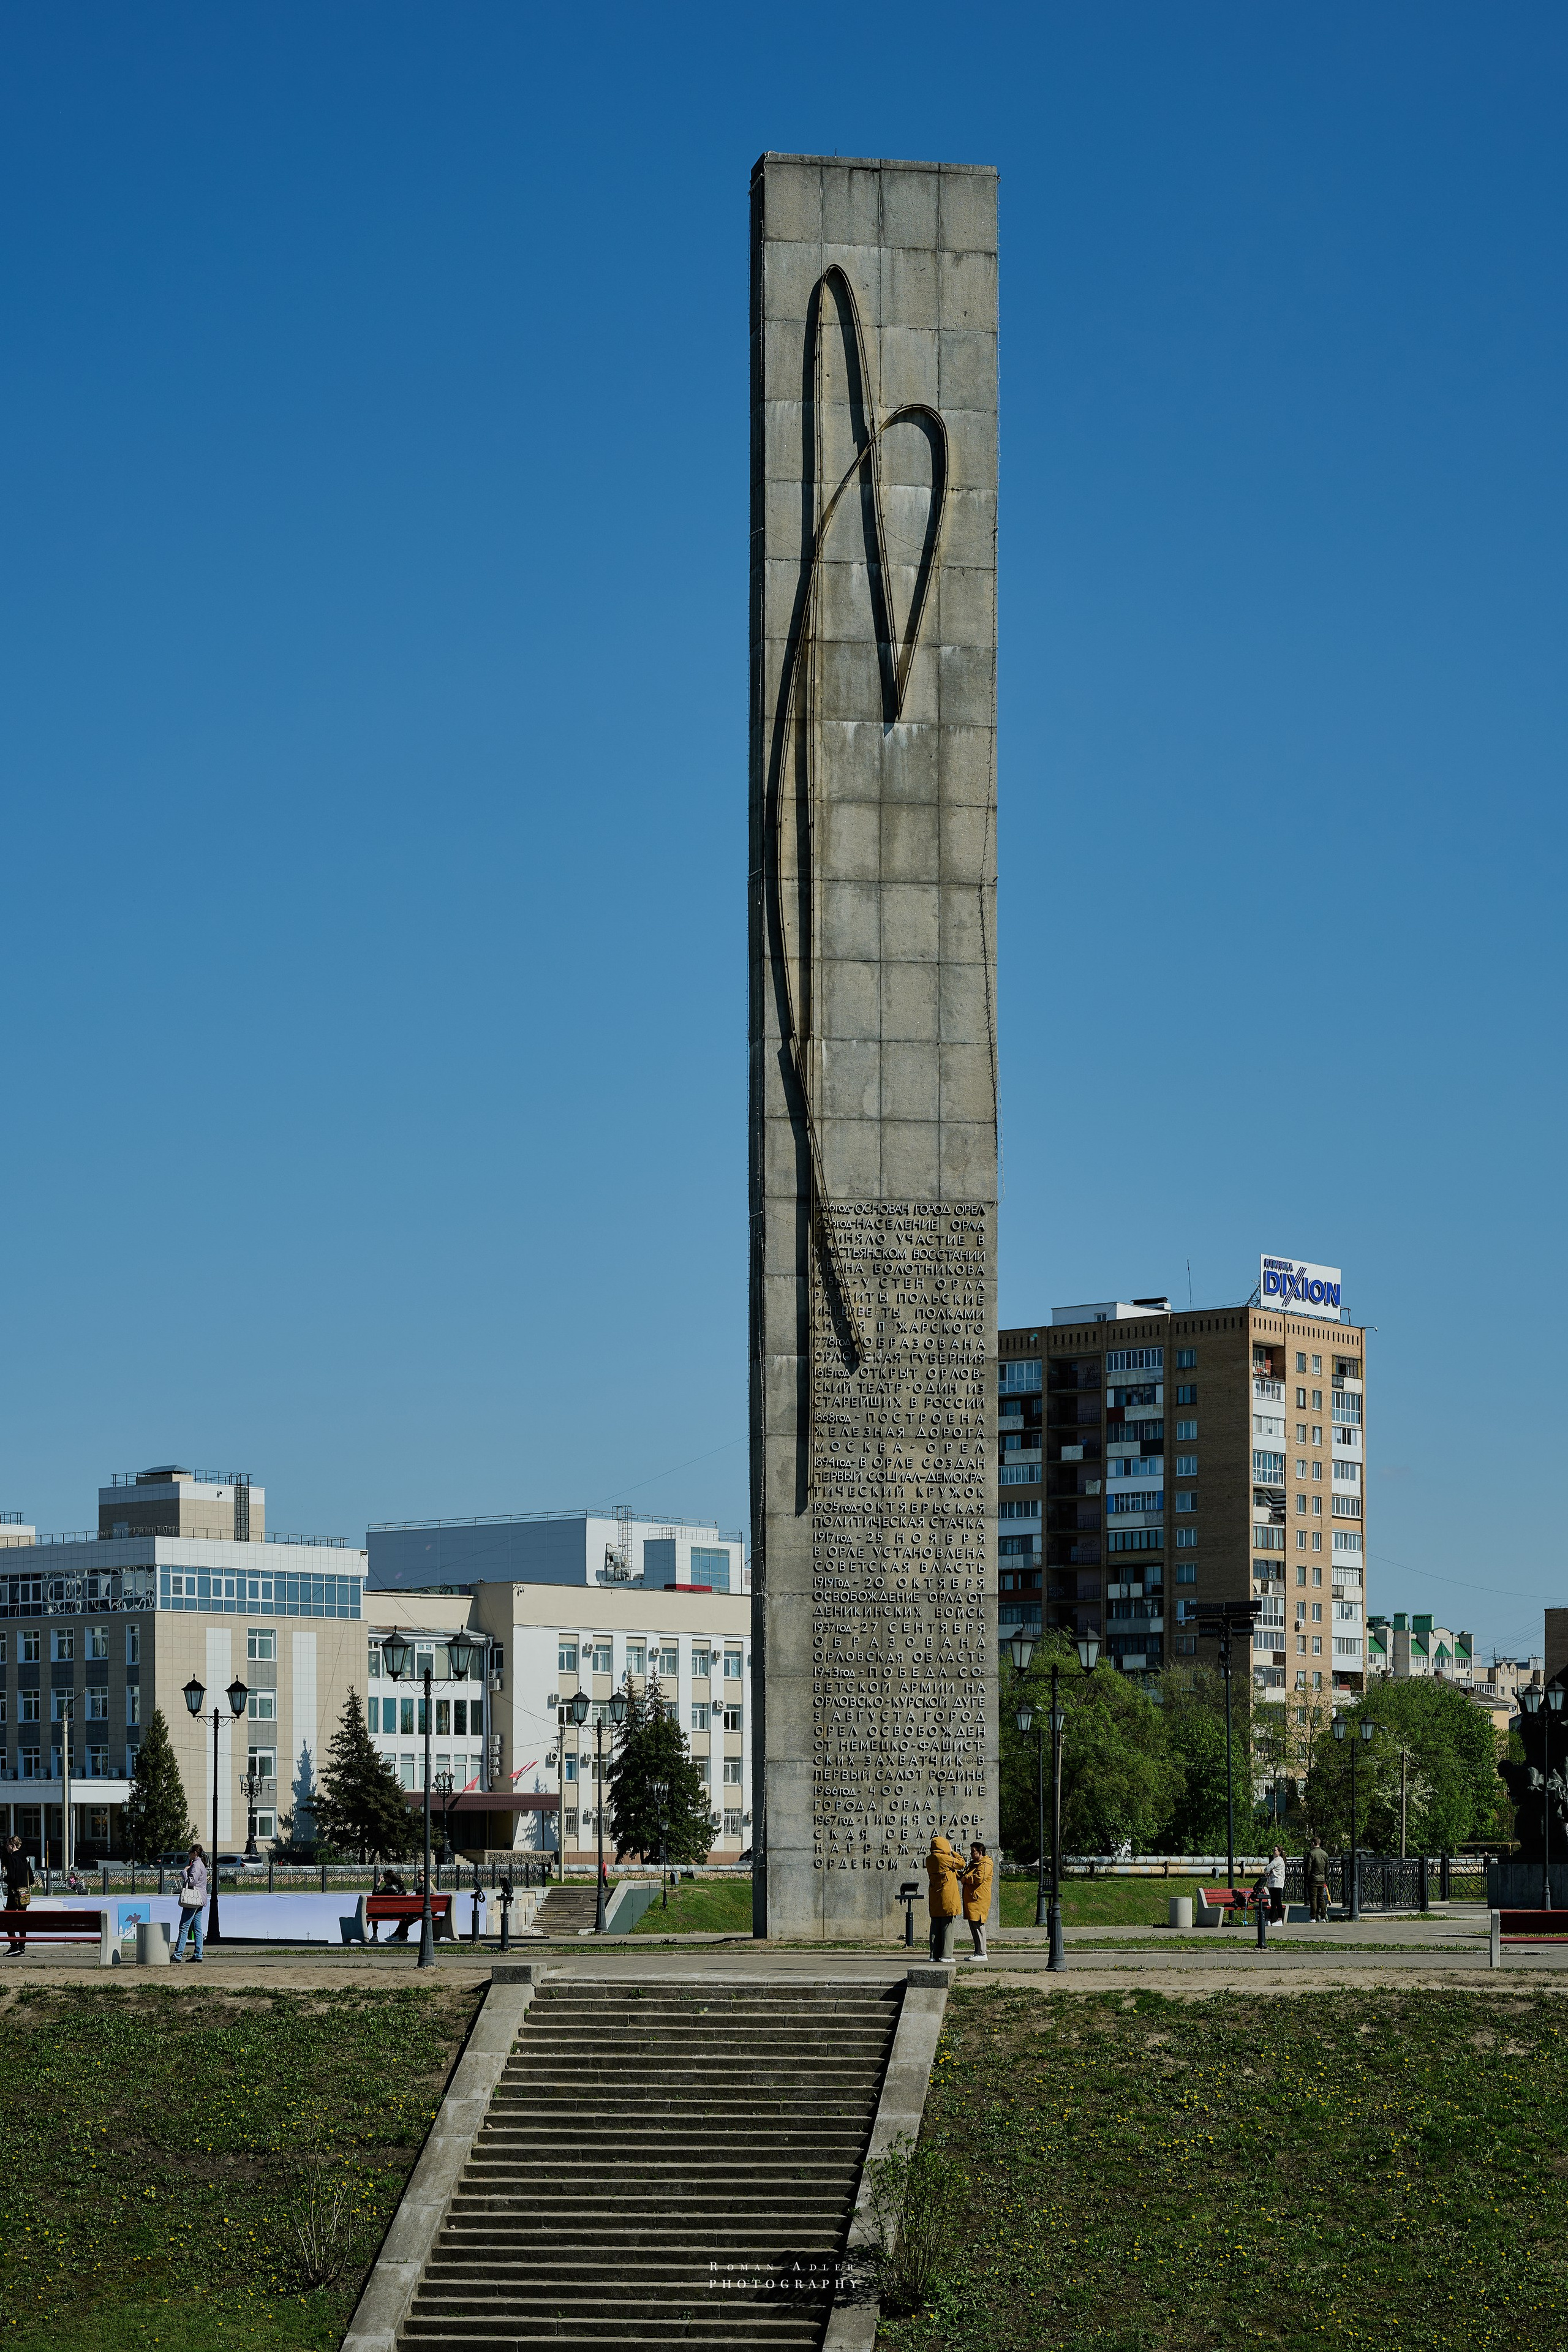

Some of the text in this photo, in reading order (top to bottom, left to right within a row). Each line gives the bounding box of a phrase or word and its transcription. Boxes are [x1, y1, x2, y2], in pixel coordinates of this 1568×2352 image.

[856, 1202, 909, 1216] ОСНОВАН
[915, 1202, 950, 1216] ГОРОД
[954, 1202, 984, 1216] ОРЕЛ
[952, 1218, 984, 1231] ОРЛА
[899, 1232, 965, 1246] УЧАСТИЕ
[979, 1232, 984, 1246] В
[913, 1246, 985, 1261] ВОССТАНИИ
[875, 1262, 984, 1275] БОЛОТНИКОВА
[861, 1278, 869, 1290] У
[880, 1278, 924, 1290] СТЕН
[937, 1278, 984, 1290] ОРЛА
[1265, 1267, 1341, 1307] DIXION
[899, 1292, 984, 1305] ПОЛЬСКИЕ
[917, 1306, 984, 1319] ПОЛКАМИ
[879, 1321, 984, 1334] ПОЖАРСКОГО
[863, 1336, 984, 1349] ОБРАЗОВАНА
[912, 1351, 985, 1364] ГУБЕРНИЯ
[860, 1366, 918, 1379] ОТКРЫТ
[928, 1366, 986, 1379] ОРЛОВ-
[815, 1382, 851, 1394] СКИЙ
[859, 1382, 902, 1394] ТЕАТР
[913, 1382, 957, 1394] ОДИН
[968, 1382, 984, 1394] ИЗ
[815, 1396, 984, 1409] СТАРЕЙШИХ В РОССИИ
[867, 1412, 984, 1423] ПОСТРОЕНА
[815, 1427, 984, 1438] ЖЕЛЕЗНАЯ ДОРОГА
[815, 1442, 902, 1453] МОСКВА
[927, 1442, 984, 1453] ОРЕЛ
[860, 1457, 866, 1469] В
[873, 1457, 913, 1469] ОРЛЕ
[923, 1457, 985, 1469] СОЗДАН
[815, 1471, 861, 1483] ПЕРВЫЙ
[813, 1485, 984, 1498] ТИЧЕСКИЙ КРУЖОК
[864, 1502, 984, 1513] ОКТЯБРЬСКАЯ
[813, 1517, 984, 1529] ПОЛИТИЧЕСКАЯ СТАЧКА
[866, 1532, 883, 1544] 25
[896, 1532, 985, 1544] НОЯБРЯ
[814, 1547, 985, 1558] В ОРЛЕ УСТАНОВЛЕНА
[814, 1561, 986, 1573] СОВЕТСКАЯ ВЛАСТЬ
[866, 1577, 884, 1588] 20
[898, 1577, 984, 1588] ОКТЯБРЯ
[814, 1591, 985, 1603] ОСВОБОЖДЕНИЕ ОРЛА ОТ
[814, 1606, 984, 1617] ДЕНИКИНСКИХ ВОЙСК
[861, 1623, 878, 1634] 27
[889, 1623, 985, 1634] СЕНТЯБРЯ
[814, 1637, 985, 1648] ОБРАЗОВАНА
[814, 1651, 986, 1662] ОРЛОВСКАЯ ОБЛАСТЬ
[869, 1667, 948, 1678] ПОБЕДА
[815, 1681, 986, 1692] ВЕТСКОЙ АРМИИ НА
[954, 1696, 986, 1707] ДУГЕ
[815, 1711, 986, 1722] 5 АВГУСТА ГОРОД
[815, 1726, 986, 1737] ОРЕЛ ОСВОБОЖДЕН
[815, 1740, 832, 1752] ОТ
[815, 1755, 984, 1765] СКИХ ЗАХВАТЧИКОВ
[815, 1769, 984, 1781] ПЕРВЫЙ САЛЮТ РОДИНЫ
[815, 1800, 932, 1811] ГОРОДА ОРЛА
[865, 1815, 868, 1825] 1
[875, 1815, 919, 1825] ИЮНЯ
[815, 1829, 983, 1839] СКАЯ ОБЛАСТЬ
[815, 1844, 963, 1853] НАГРАЖДН
[815, 1858, 898, 1869] ОРДЕНОМ
